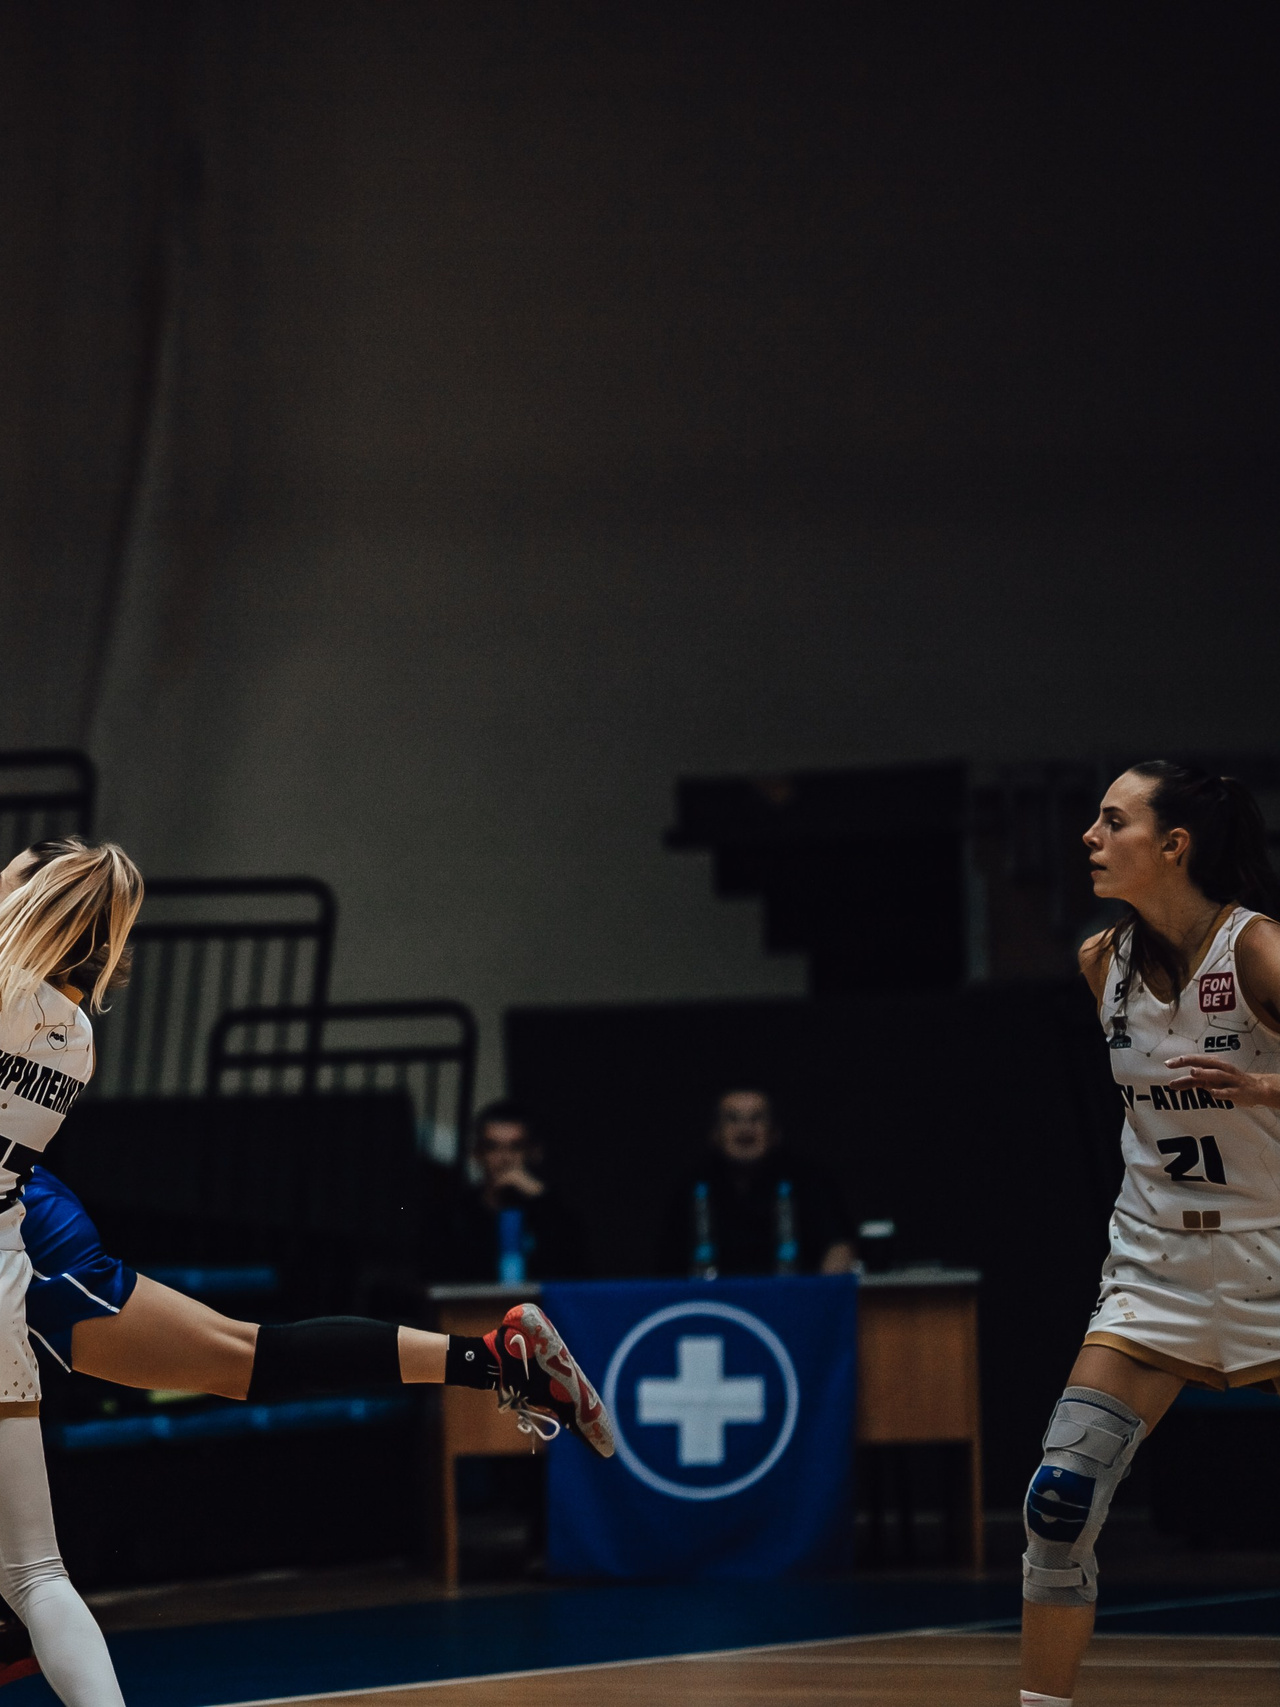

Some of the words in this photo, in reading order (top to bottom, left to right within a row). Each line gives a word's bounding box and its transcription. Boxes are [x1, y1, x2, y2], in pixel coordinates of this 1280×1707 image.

[1201, 977, 1232, 992] FON
[1203, 991, 1233, 1008] BET
[1157, 1135, 1228, 1185] 21
